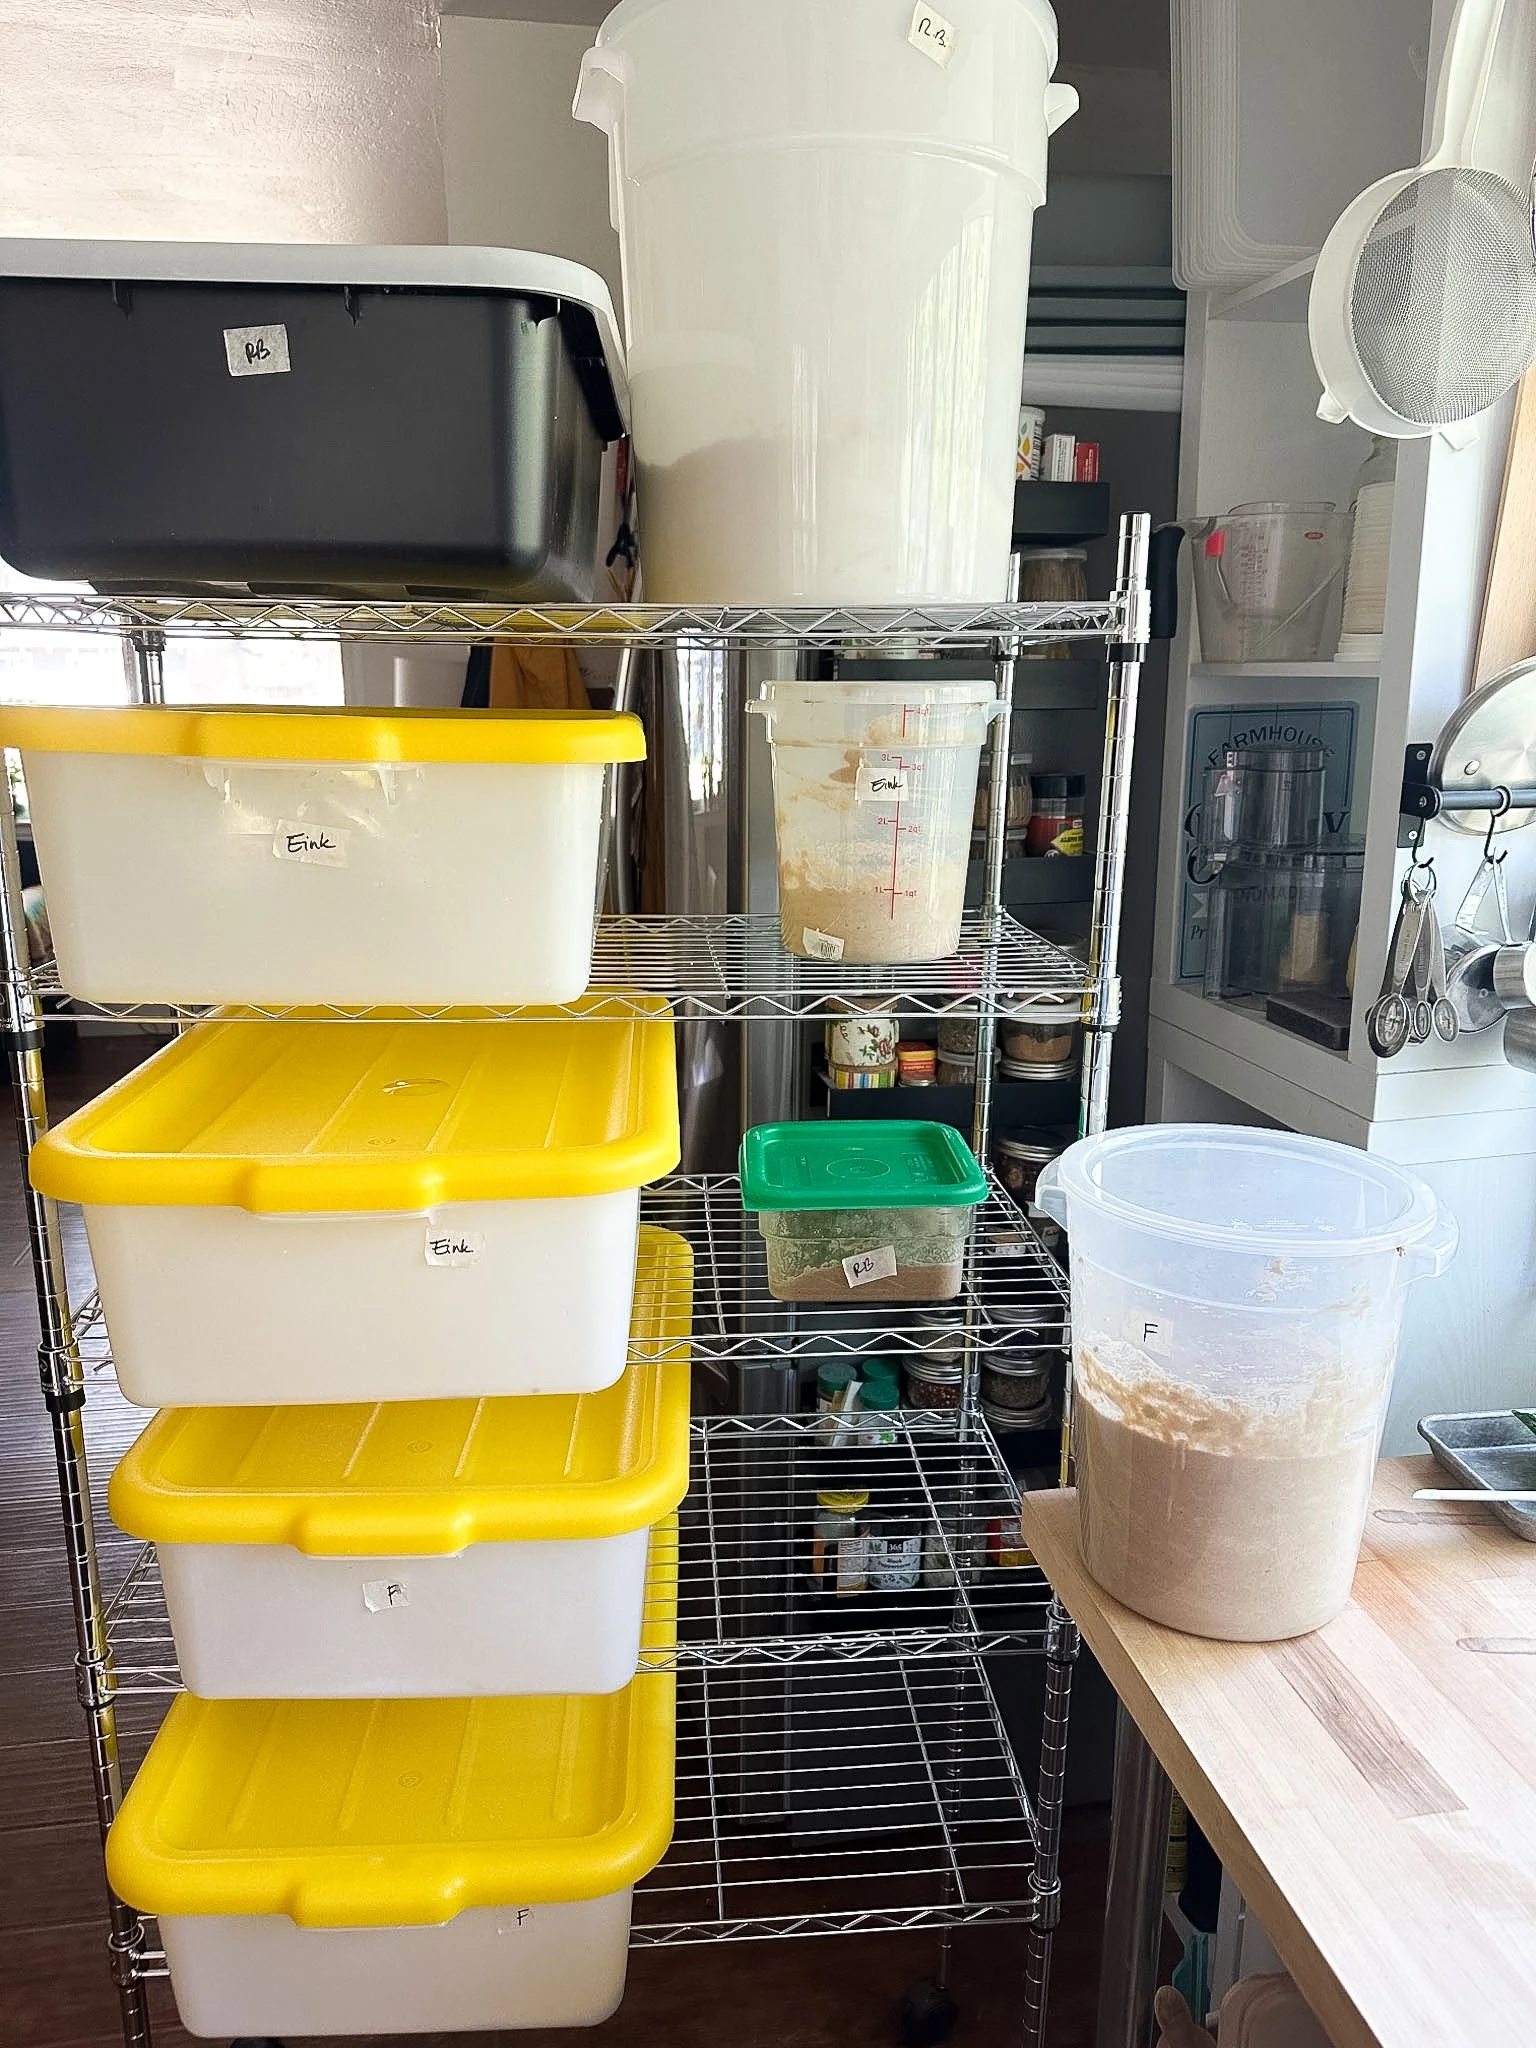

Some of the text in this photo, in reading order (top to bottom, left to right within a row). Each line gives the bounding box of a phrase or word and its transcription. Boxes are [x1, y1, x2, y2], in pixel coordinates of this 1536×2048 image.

[245, 338, 271, 365] RB
[286, 832, 337, 853] Eink
[429, 1238, 475, 1256] Eink
[853, 1257, 875, 1279] RB
[1143, 1322, 1159, 1343] F
[516, 1908, 530, 1927] F
